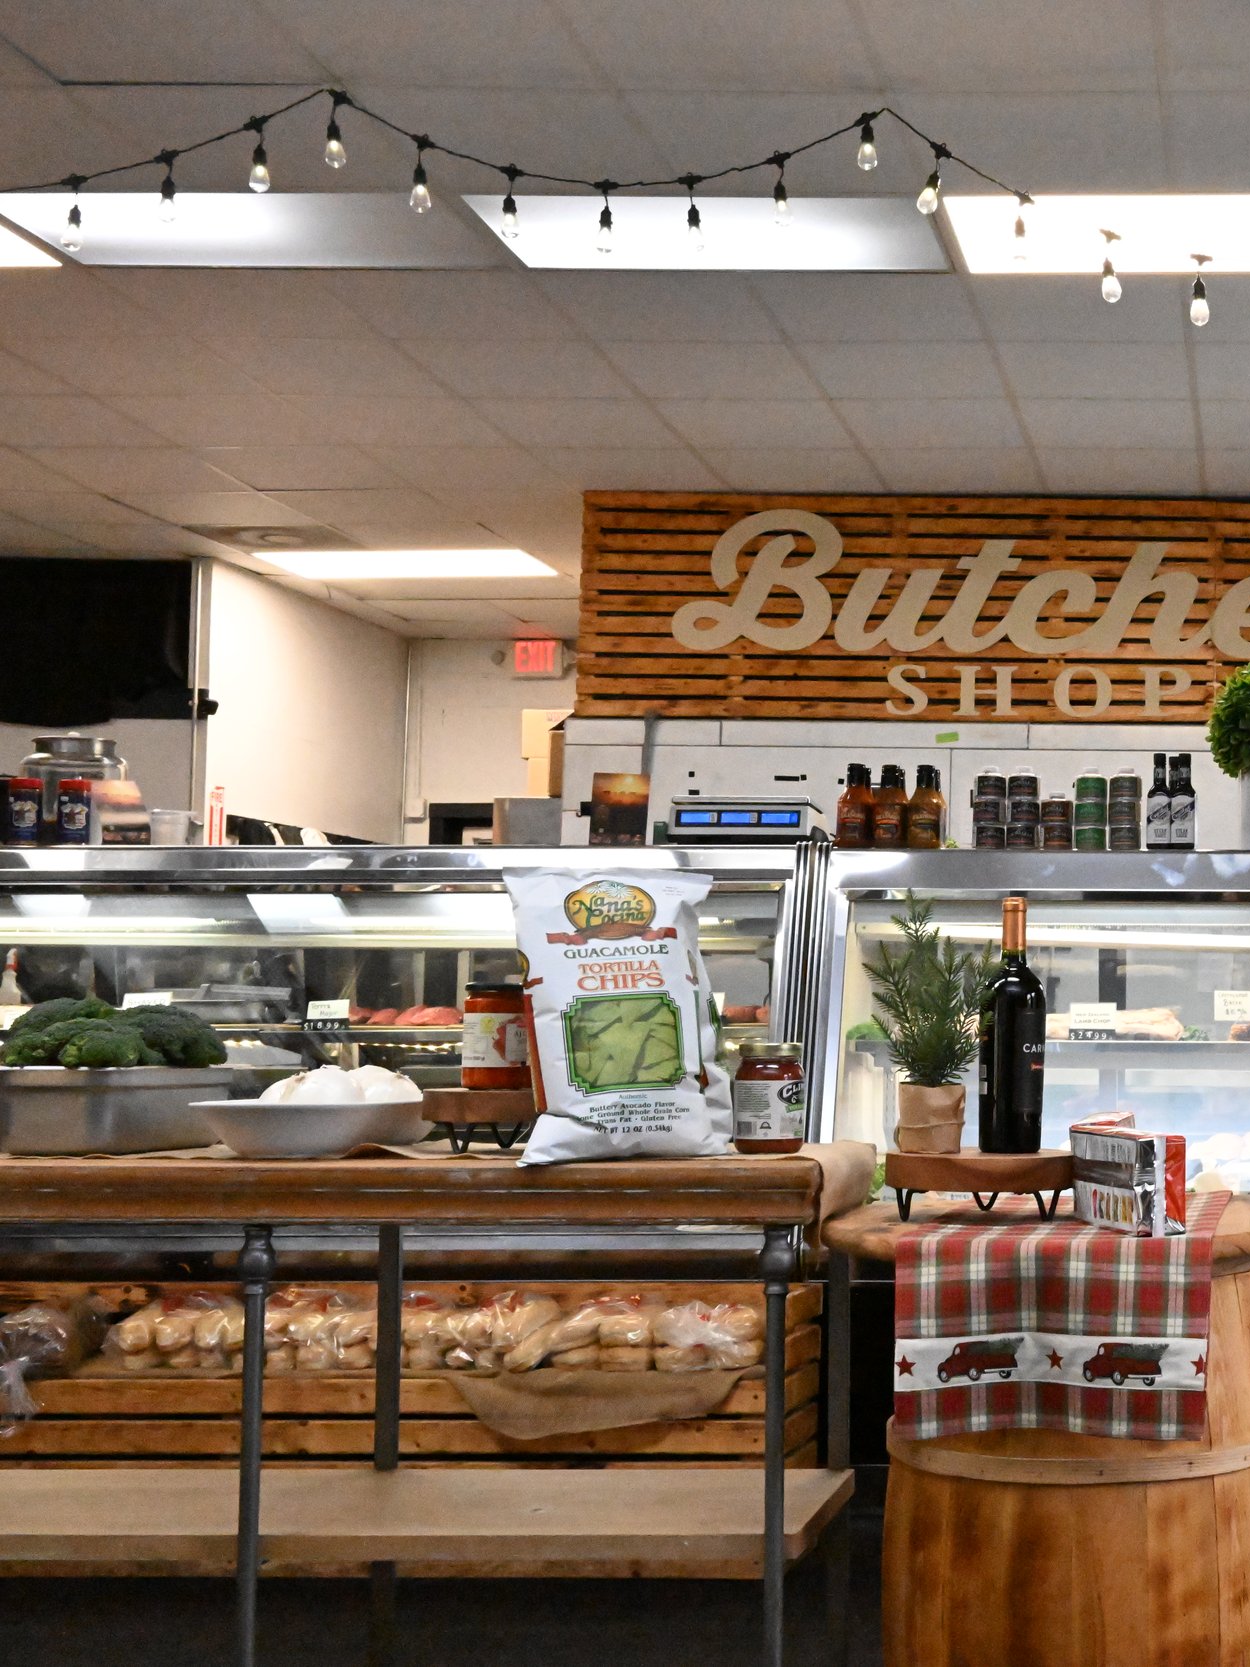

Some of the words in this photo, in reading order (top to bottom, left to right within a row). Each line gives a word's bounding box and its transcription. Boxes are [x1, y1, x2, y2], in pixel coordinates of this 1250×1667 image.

[514, 641, 557, 673] EXIT
[885, 664, 1192, 717] SHOP
[572, 895, 644, 915] Nana's
[586, 908, 647, 928] Cocina
[563, 944, 669, 959] GUACAMOLE
[578, 960, 660, 974] TORTILLA
[577, 972, 665, 992] CHIPS
[1022, 1043, 1045, 1053] CAR
[589, 1103, 618, 1114] Buttery
[620, 1101, 652, 1110] Avocado
[654, 1101, 676, 1109] Flavor
[597, 1109, 625, 1119] Ground
[628, 1108, 651, 1116] Whole
[653, 1107, 673, 1115] Grain
[675, 1106, 691, 1114] Corn
[619, 1115, 633, 1123] Fat
[640, 1114, 665, 1122] Gluten
[622, 1126, 631, 1134] 12
[633, 1124, 643, 1133] OZ
